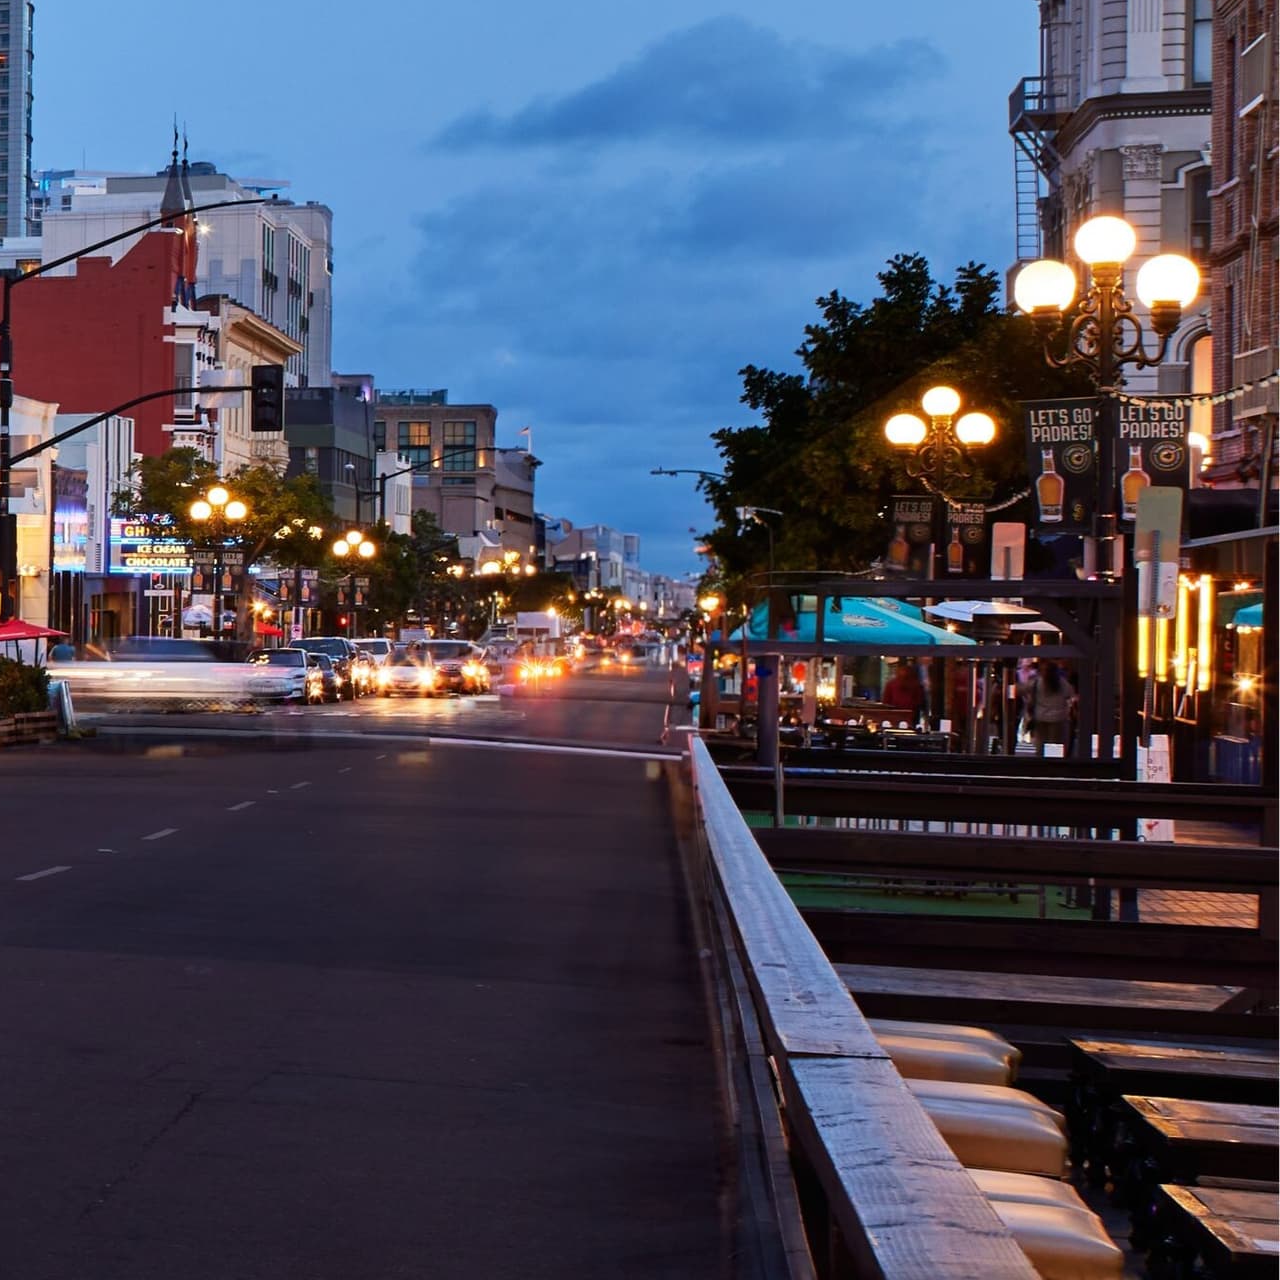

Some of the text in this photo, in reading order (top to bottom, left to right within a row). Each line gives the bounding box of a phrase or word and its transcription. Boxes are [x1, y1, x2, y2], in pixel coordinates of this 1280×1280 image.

[1030, 407, 1093, 426] LET'S GO
[1120, 404, 1185, 422] LET'S GO
[1031, 424, 1093, 443] PADRES!
[1120, 421, 1185, 439] PADRES!
[137, 545, 186, 554] ICE CREAM
[125, 557, 188, 567] CHOCOLATE
